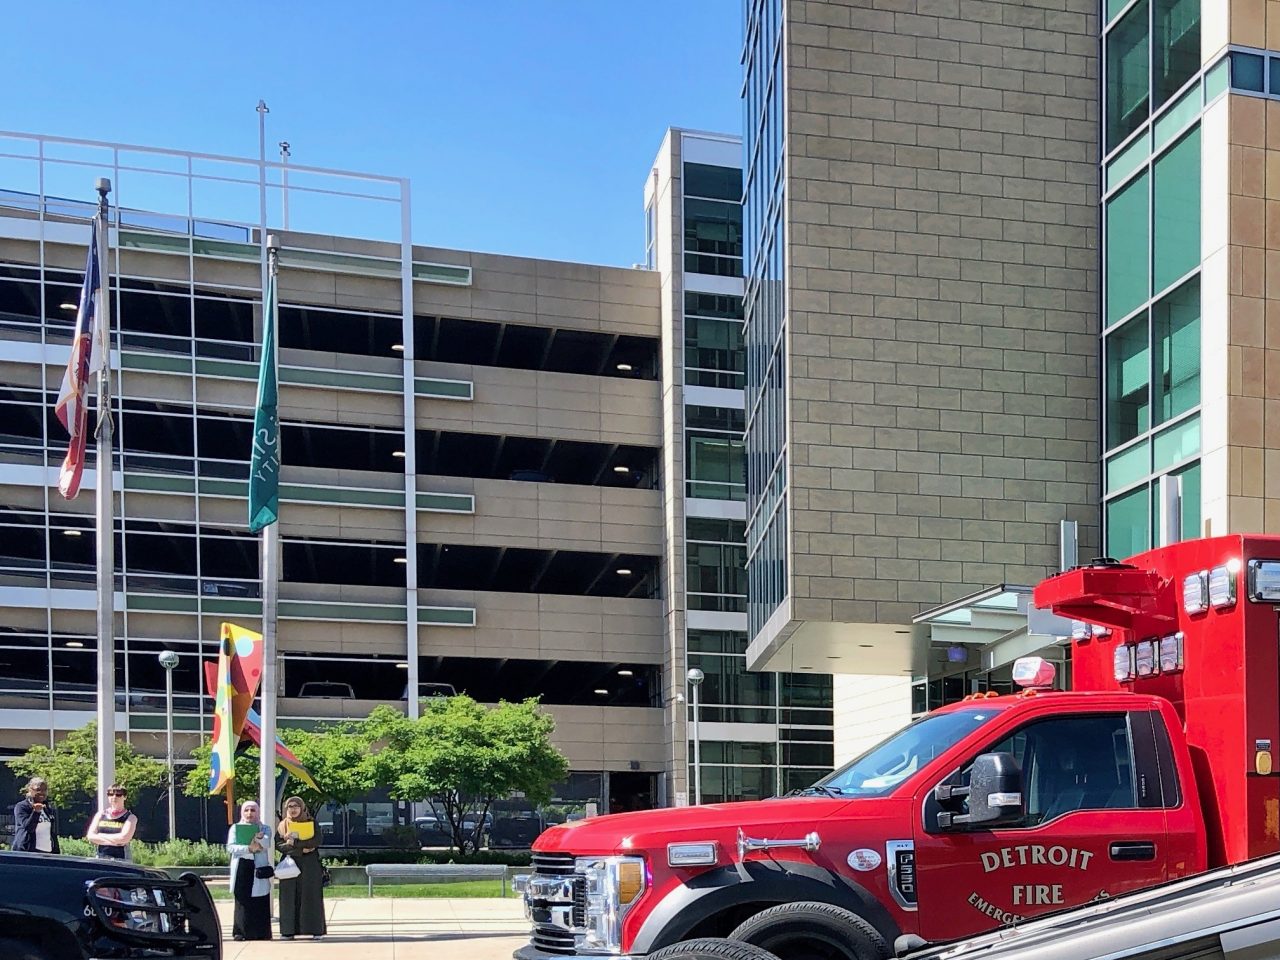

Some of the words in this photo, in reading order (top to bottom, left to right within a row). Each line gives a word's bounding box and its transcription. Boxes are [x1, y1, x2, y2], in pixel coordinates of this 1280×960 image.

[980, 845, 1095, 873] DETROIT
[967, 891, 1027, 926] EMERGE
[1012, 884, 1065, 906] FIRE
